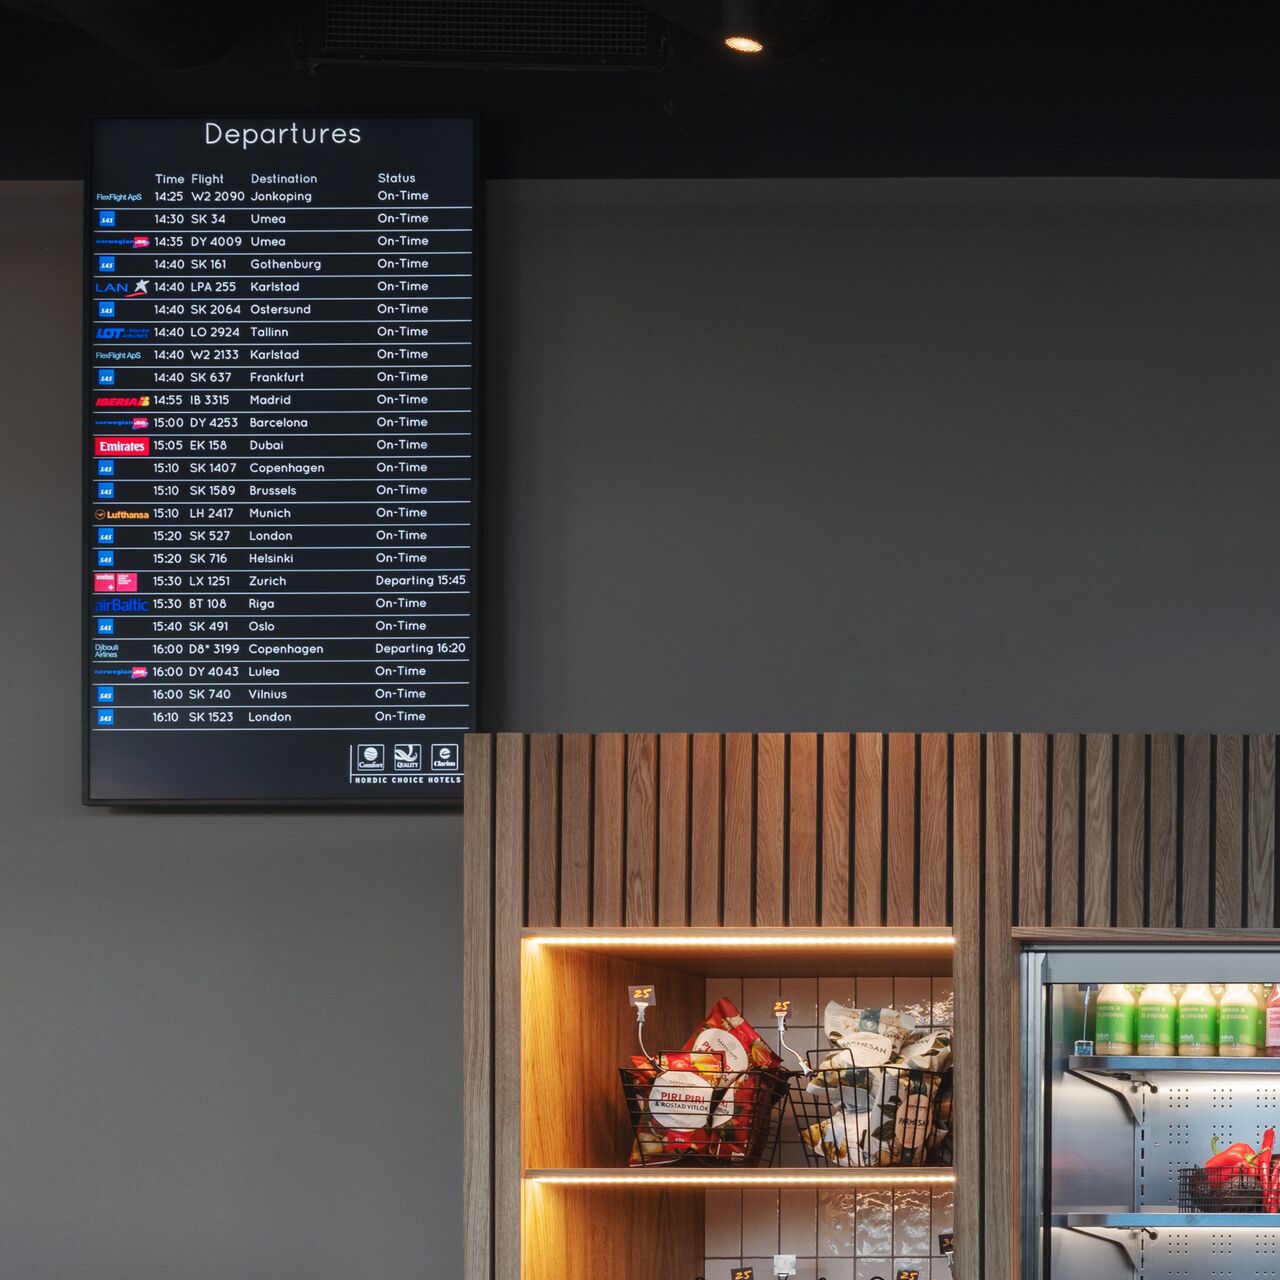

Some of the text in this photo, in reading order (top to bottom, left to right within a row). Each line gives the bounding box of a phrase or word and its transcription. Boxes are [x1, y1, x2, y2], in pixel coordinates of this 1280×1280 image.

[205, 122, 361, 150] Departures
[155, 173, 416, 186] Time Flight Destination Status
[96, 190, 429, 203] FlexFlight ApS 14:25 W2 2090 Jonkoping On-Time
[154, 212, 429, 224] 14:30 SK 34 Umea On-Time
[154, 258, 429, 271] 14:40 SK 161 Gothenburg On-Time
[95, 280, 429, 293] LAN 14:40 LPA 255 Karlstad On-Time
[95, 327, 125, 339] LOT
[154, 326, 185, 338] 14:40
[190, 326, 207, 338] LO
[210, 326, 240, 338] 2924
[250, 326, 289, 337] Tallinn
[376, 325, 429, 337] On-Time
[153, 371, 429, 383] 14:40 SK 637 Frankfurt On-Time
[95, 393, 428, 407] IBERIA 14:55 IB 3315 Madrid On-Time
[100, 439, 428, 452] Emirates 15:05 EK 158 Dubai On-Time
[153, 461, 428, 475] 15:10 SK 1407 Copenhagen On-Time
[107, 507, 428, 519] Lufthansa 15:10 LH 2417 Munich On-Time
[153, 552, 427, 564] 15:20 SK 716 Helsinki On-Time
[152, 574, 466, 588] 15:30 LX 1251 Zurich Departing 15:45
[95, 597, 427, 612] airBaltic 15:30 BT 108 Riga On-Time
[152, 688, 426, 700] 16:00 SK 740 Vilnius On-Time
[152, 710, 426, 723] 16:10 SK 1523 London On-Time
[355, 776, 461, 784] NORDIC CHOICE HOTELS
[633, 988, 652, 999] 25
[773, 1001, 790, 1011] 25
[841, 1040, 888, 1055] PARMESAN
[660, 1091, 706, 1105] PIRI PIRI
[735, 1269, 752, 1280] 25
[900, 1271, 918, 1280] 25
